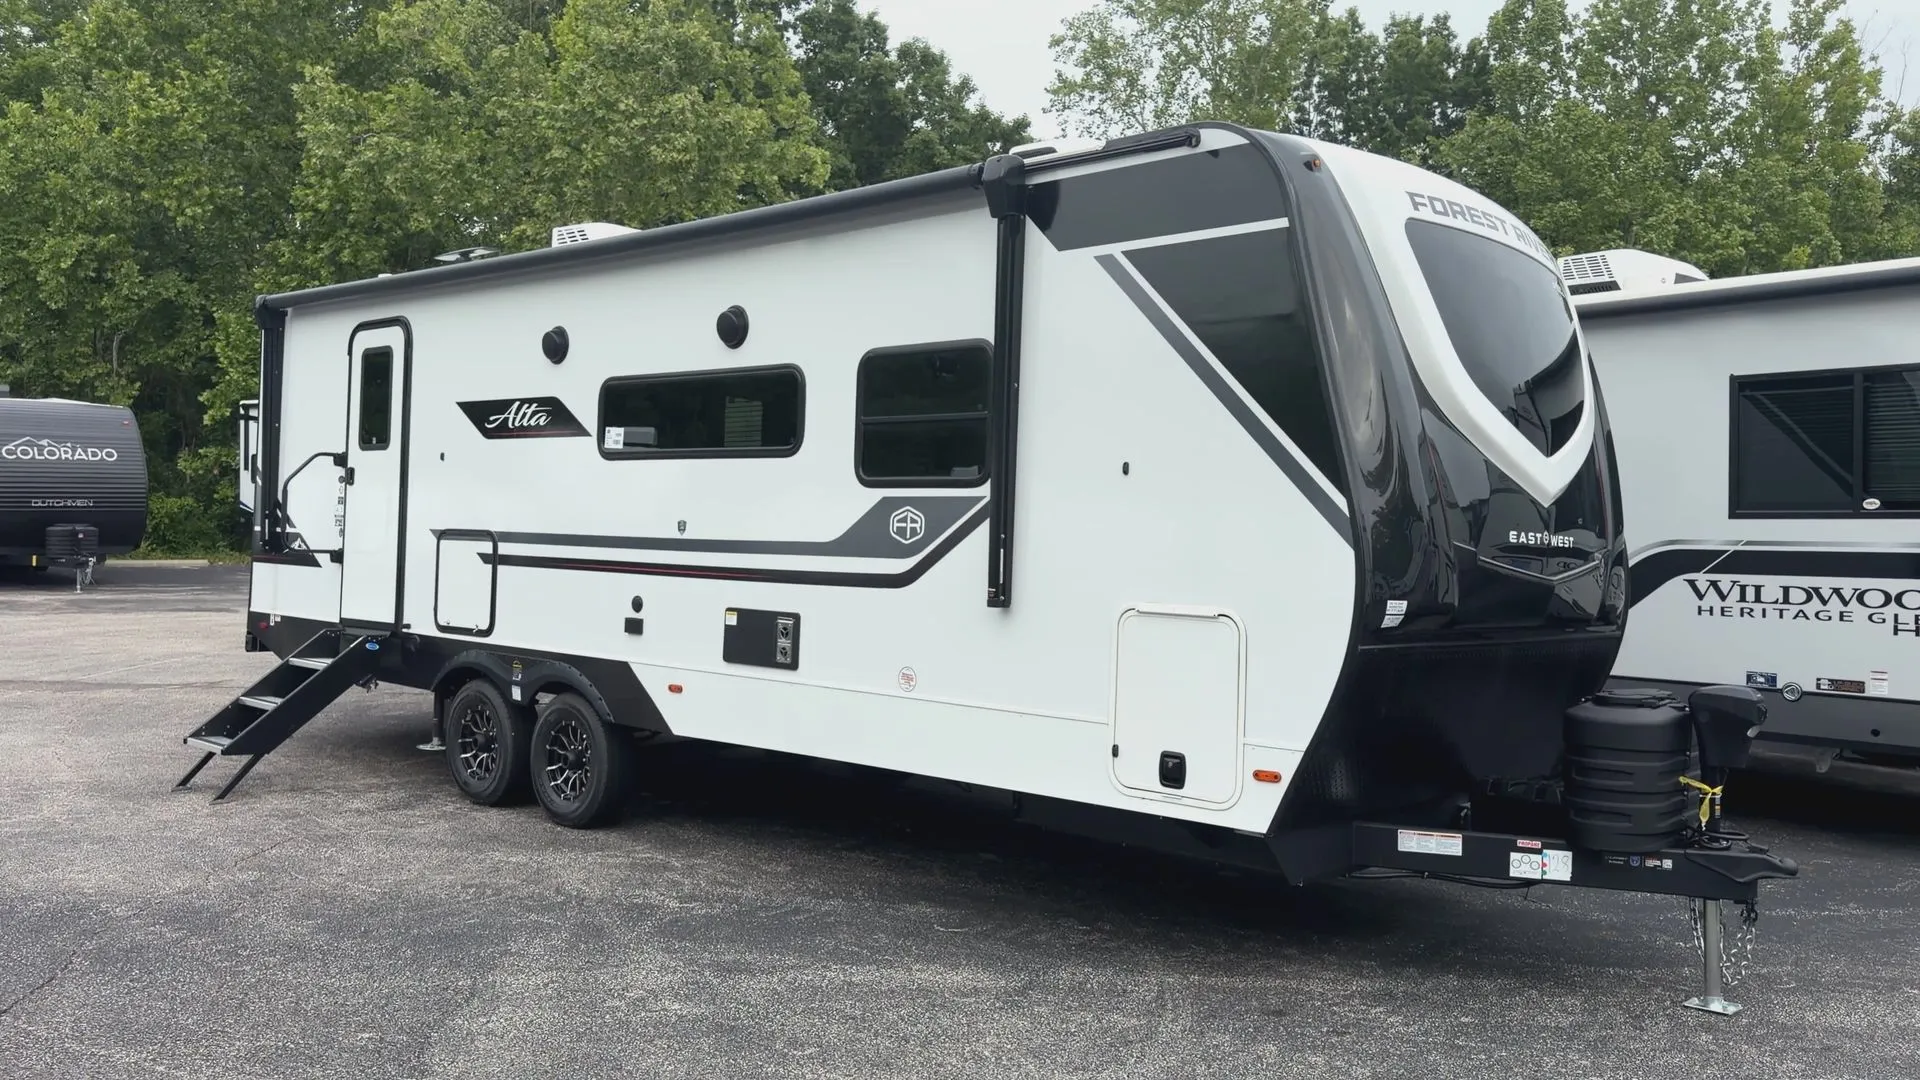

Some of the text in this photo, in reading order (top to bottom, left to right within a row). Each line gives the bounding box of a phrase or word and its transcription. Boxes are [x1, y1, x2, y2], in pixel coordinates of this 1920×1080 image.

[1405, 190, 1555, 264] FOREST RIVE
[484, 400, 553, 429] Alta
[1, 445, 118, 461] COLORADO
[31, 499, 94, 507] DUTCHMEN
[1508, 530, 1574, 549] EAST WEST
[1697, 605, 1854, 622] HERITAGE
